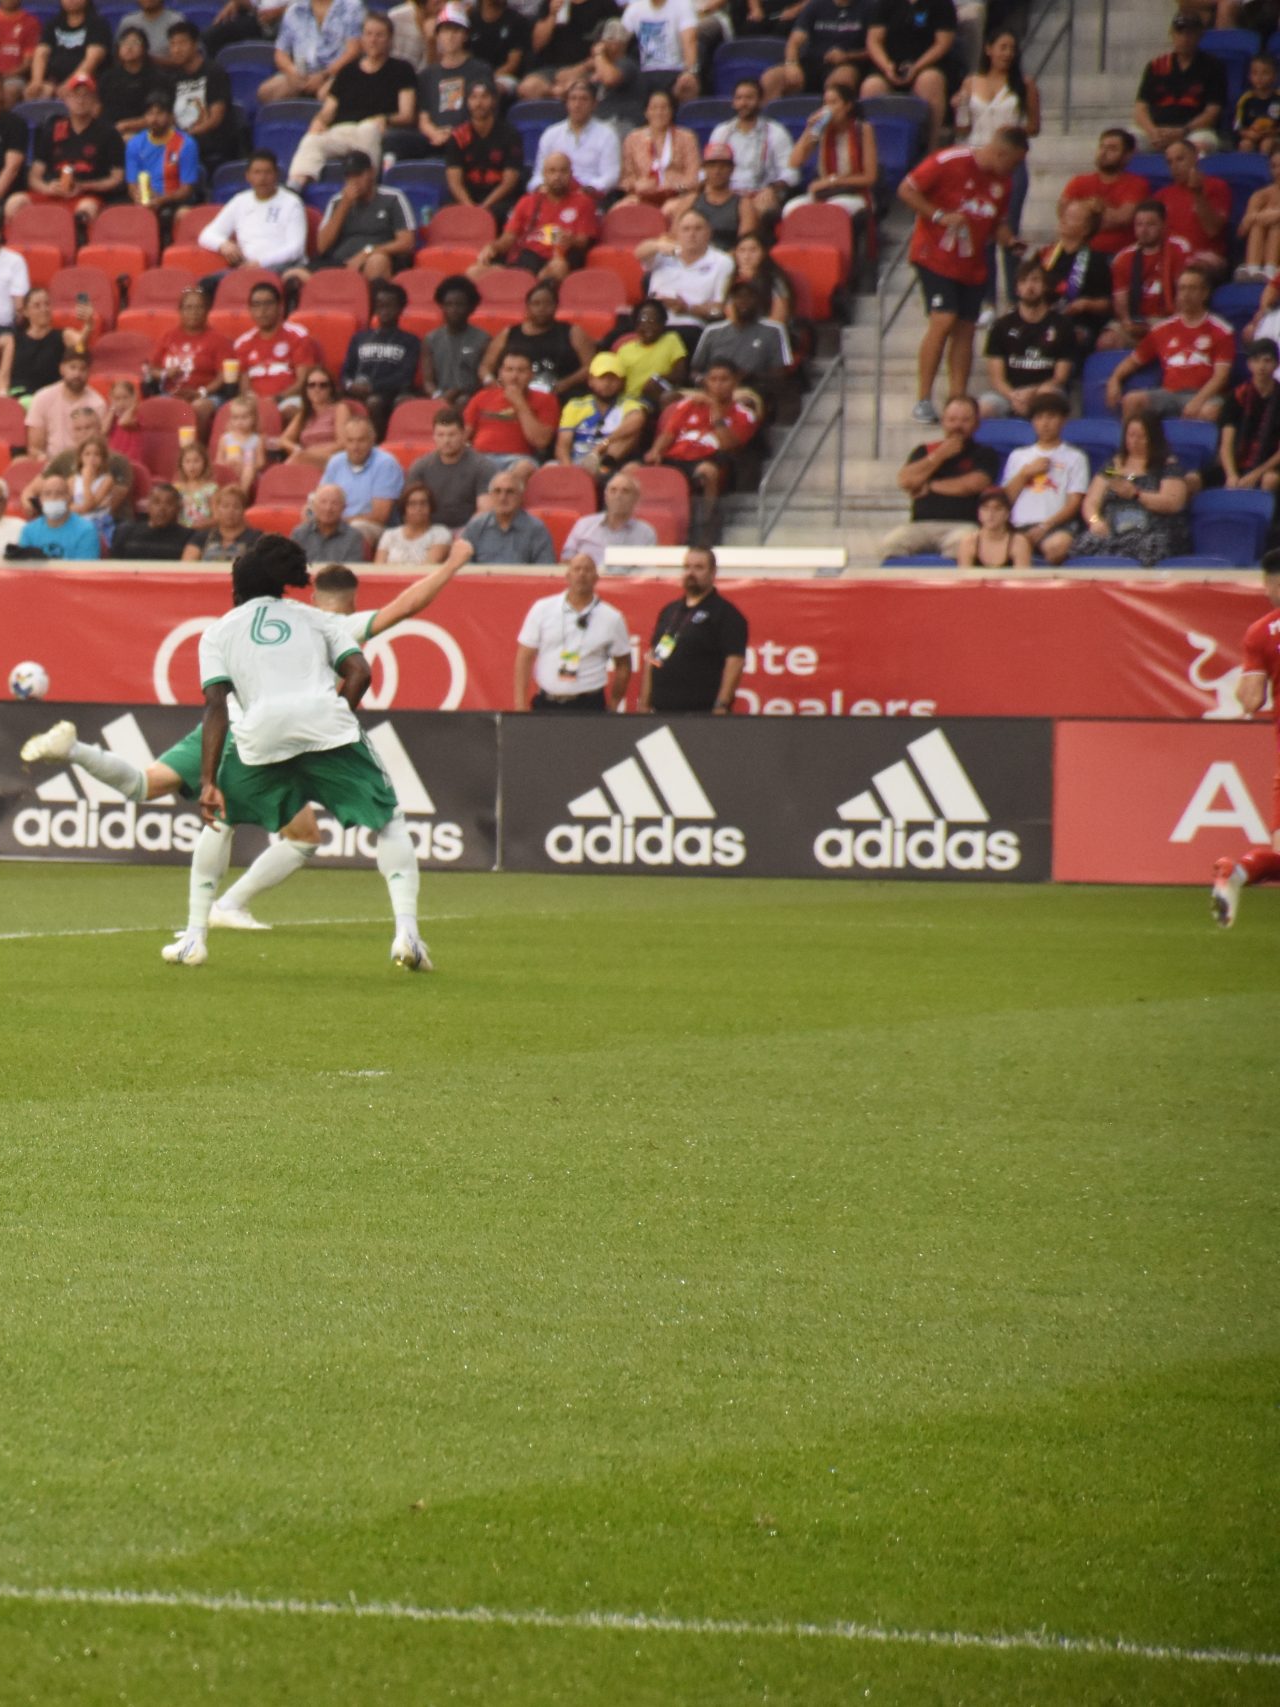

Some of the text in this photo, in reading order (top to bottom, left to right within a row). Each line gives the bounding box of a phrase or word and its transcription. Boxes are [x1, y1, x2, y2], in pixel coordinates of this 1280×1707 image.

[250, 606, 291, 645] 6
[12, 800, 203, 852] adidas
[1169, 762, 1271, 844] A
[545, 814, 746, 866] adidas
[814, 817, 1021, 870] adidas
